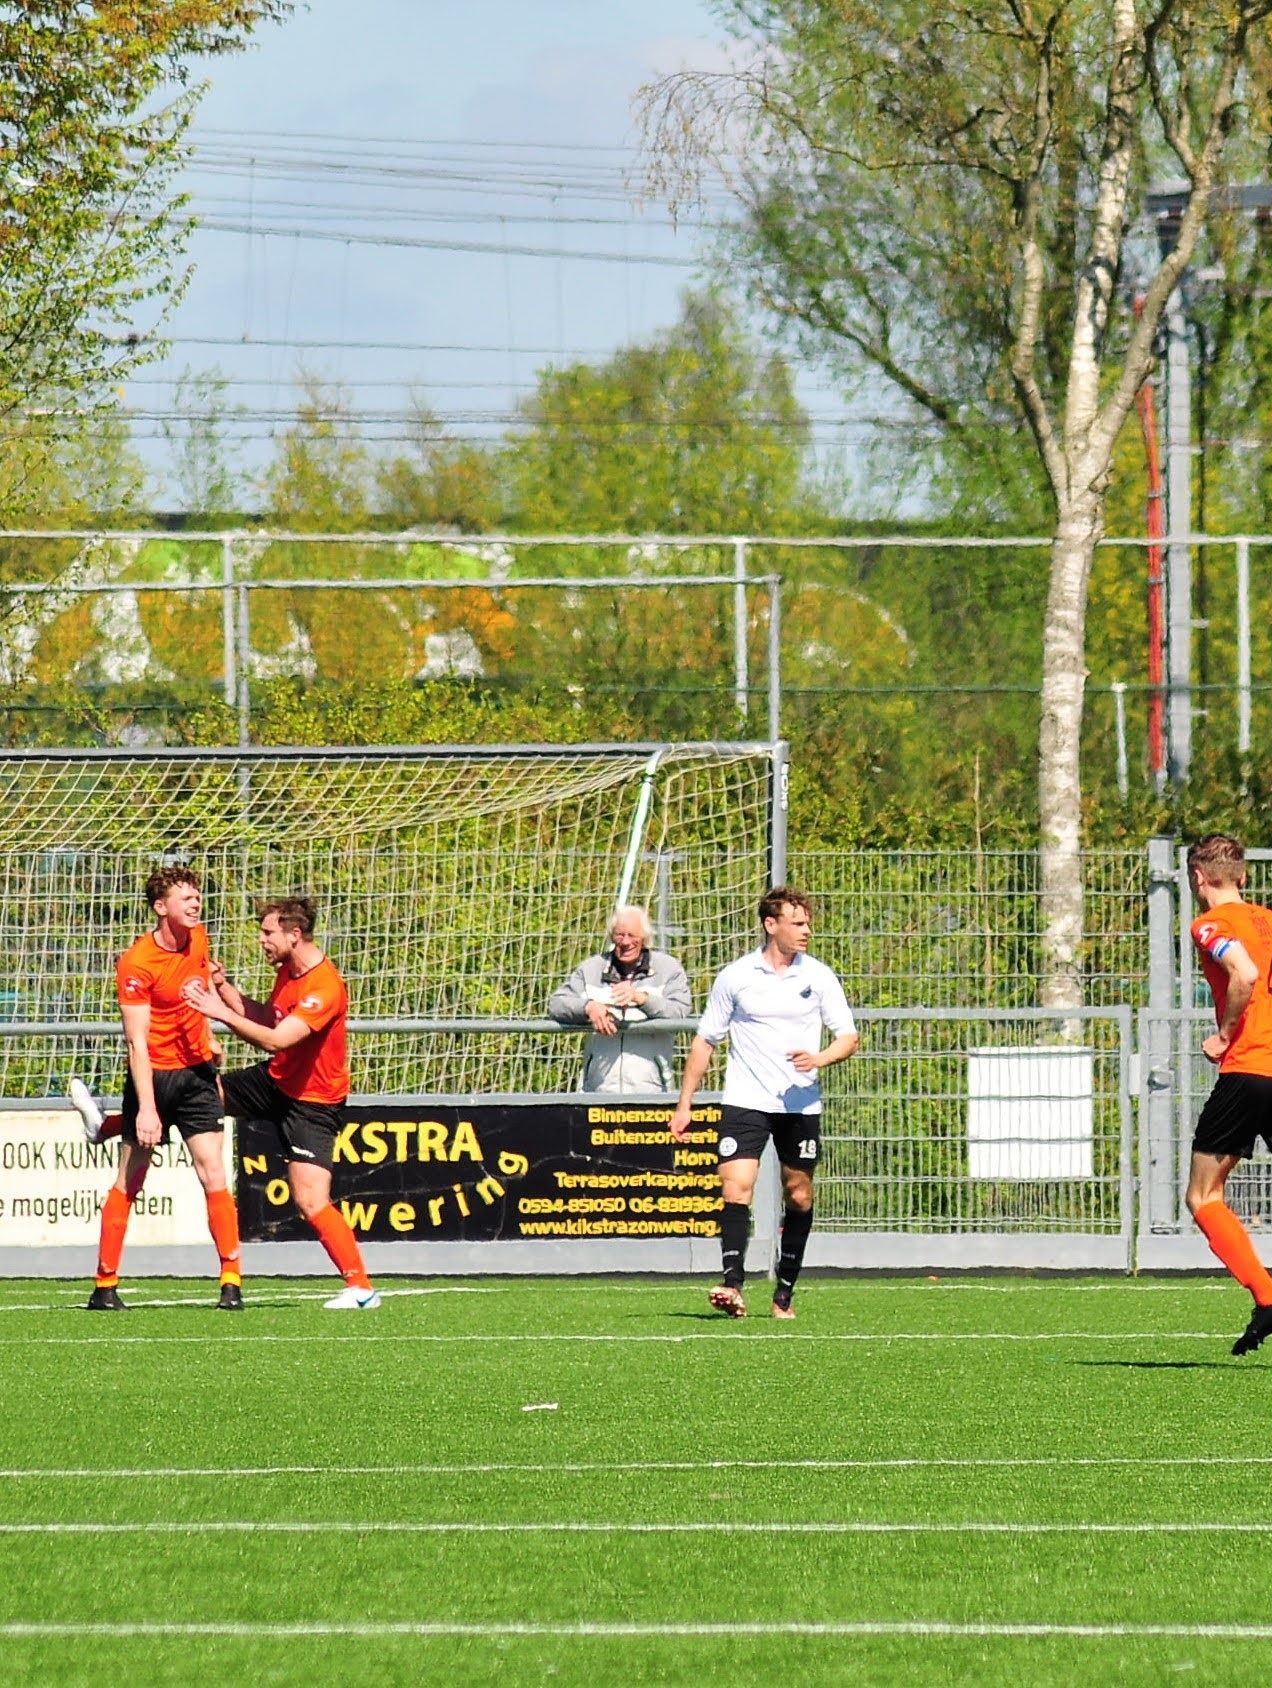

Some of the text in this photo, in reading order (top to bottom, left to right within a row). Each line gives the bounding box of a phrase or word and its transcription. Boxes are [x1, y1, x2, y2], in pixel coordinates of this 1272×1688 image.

[588, 1107, 722, 1123] Binnenzonerin
[332, 1121, 484, 1164] KSTRA
[798, 1139, 817, 1154] 18
[3, 1141, 47, 1169] OOK
[55, 1141, 122, 1169] KUNN
[242, 1150, 529, 1232] zowering
[12, 1188, 173, 1224] mogelijkden
[518, 1196, 726, 1214] 0594-851050 06-8319364
[518, 1217, 722, 1237] www.kikstrazonwering.
